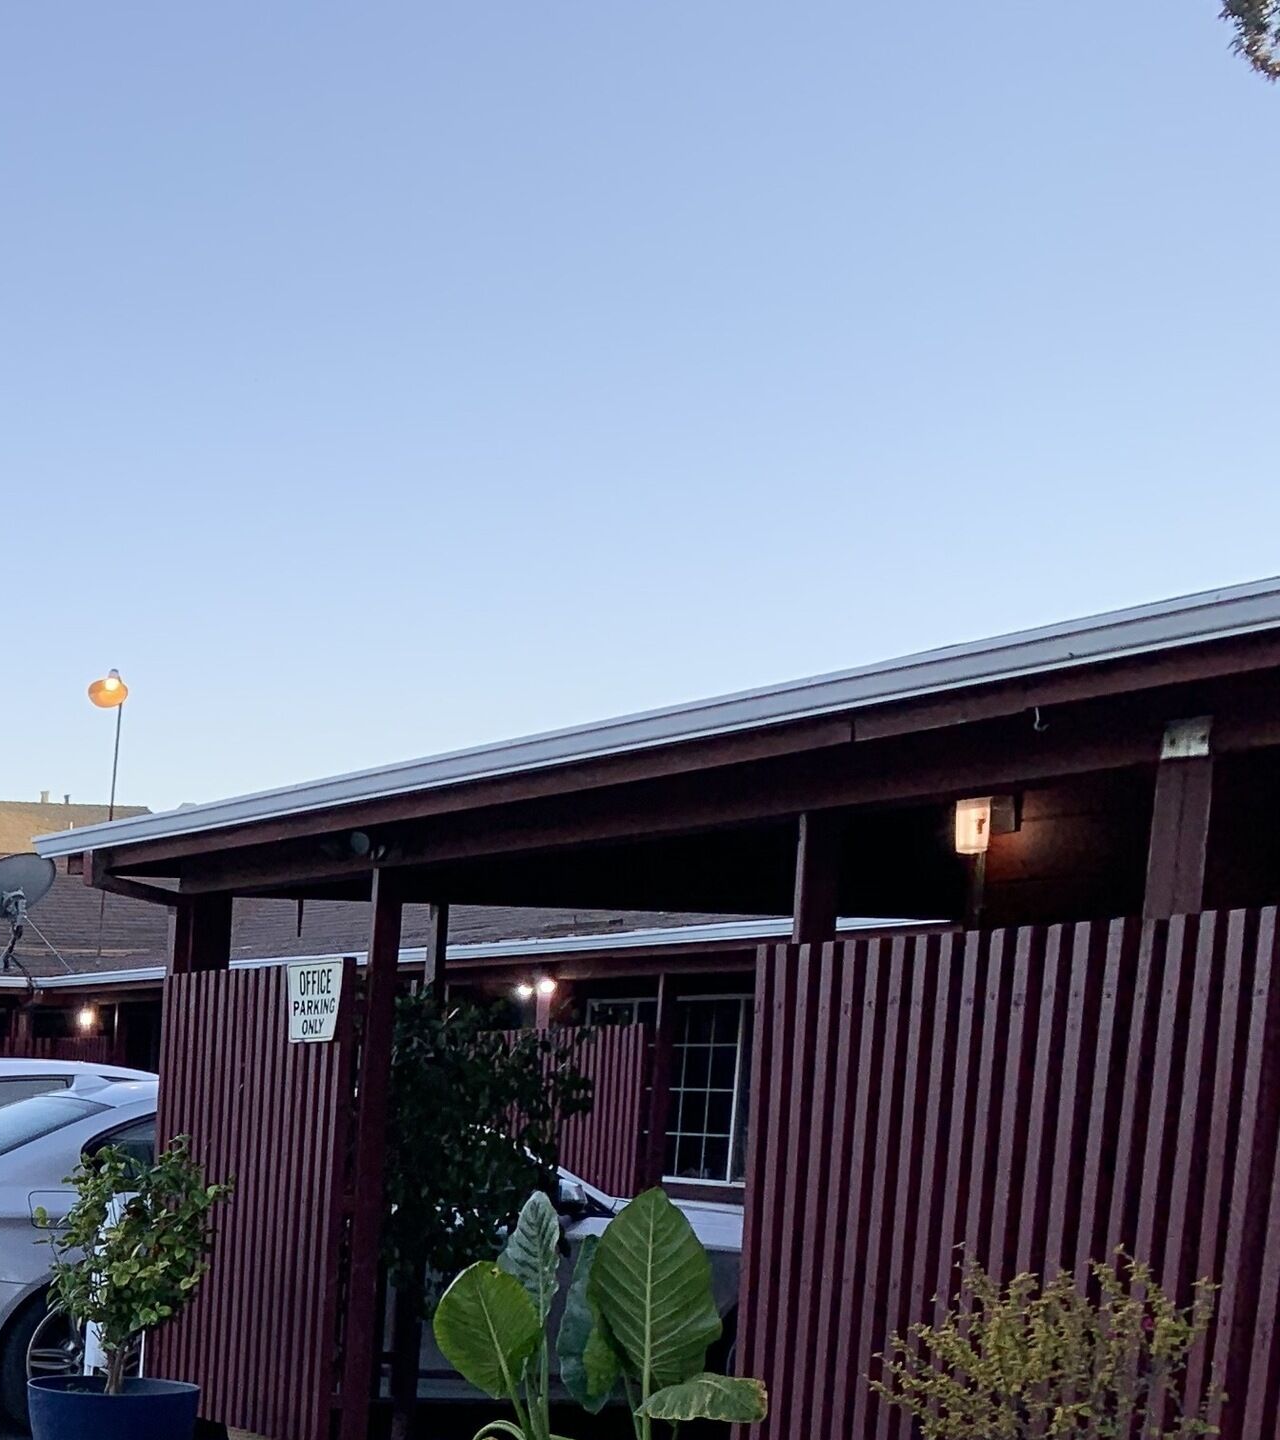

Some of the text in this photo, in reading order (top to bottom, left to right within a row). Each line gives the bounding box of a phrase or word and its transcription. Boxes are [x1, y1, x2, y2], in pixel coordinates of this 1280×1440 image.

[299, 969, 332, 996] OFFICE
[293, 998, 336, 1017] PARKING
[301, 1018, 325, 1036] ONLY
